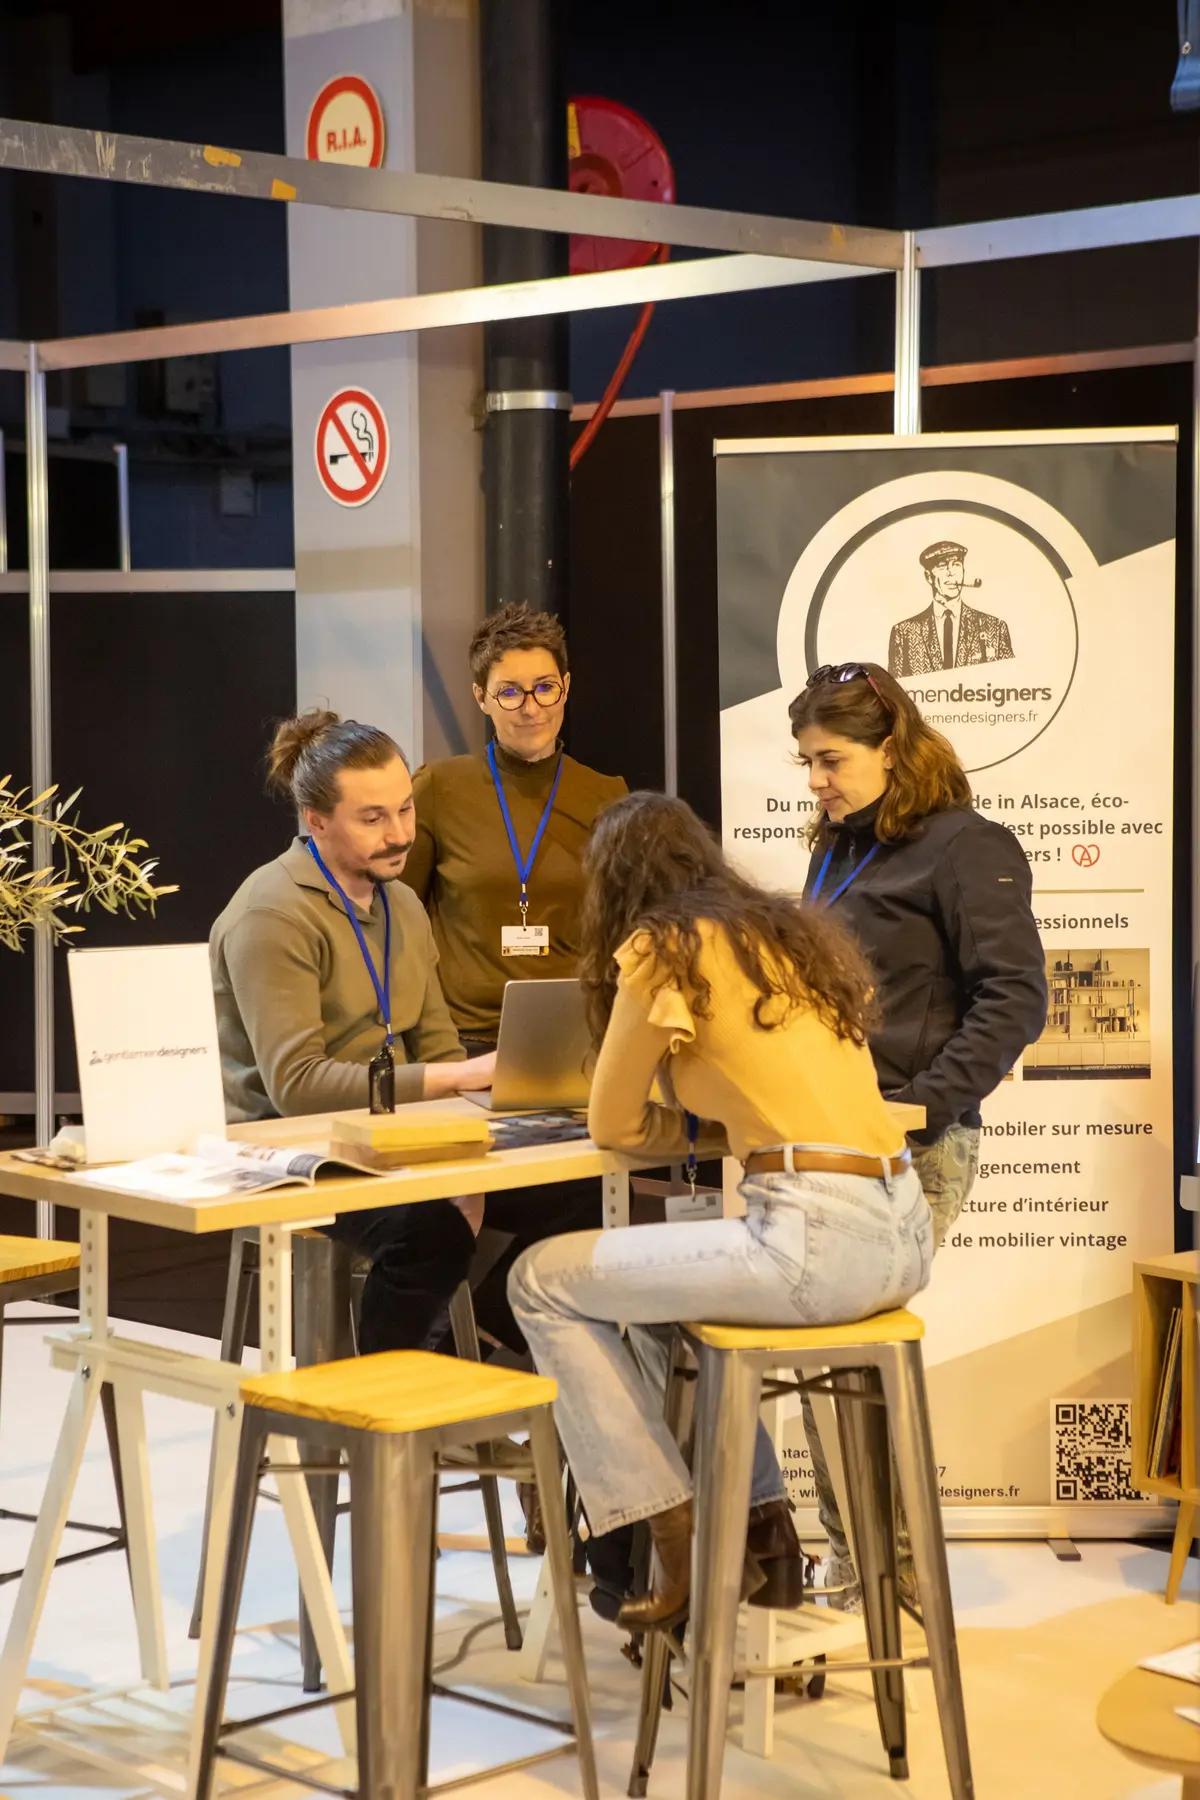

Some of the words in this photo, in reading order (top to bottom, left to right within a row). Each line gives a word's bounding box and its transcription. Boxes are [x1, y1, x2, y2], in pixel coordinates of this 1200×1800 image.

[327, 126, 367, 153] R.I.A.
[905, 683, 1053, 707] mendesigners
[766, 798, 791, 813] Du
[972, 794, 992, 810] de
[998, 794, 1015, 809] in
[1021, 793, 1086, 811] Alsace,
[1091, 793, 1129, 809] éco-
[733, 826, 811, 843] respons
[1040, 819, 1116, 840] possible
[1121, 821, 1163, 834] avec
[1026, 849, 1051, 862] ers
[1035, 913, 1129, 930] essionnels
[1051, 1123, 1081, 1136] sur
[1086, 1122, 1153, 1136] mesure
[976, 1160, 1081, 1179] gencement
[961, 1199, 1007, 1213] cture
[1013, 1197, 1109, 1213] d’intérieur
[952, 1232, 973, 1248] de
[979, 1232, 1055, 1248] mobilier
[1060, 1232, 1128, 1251] vintage
